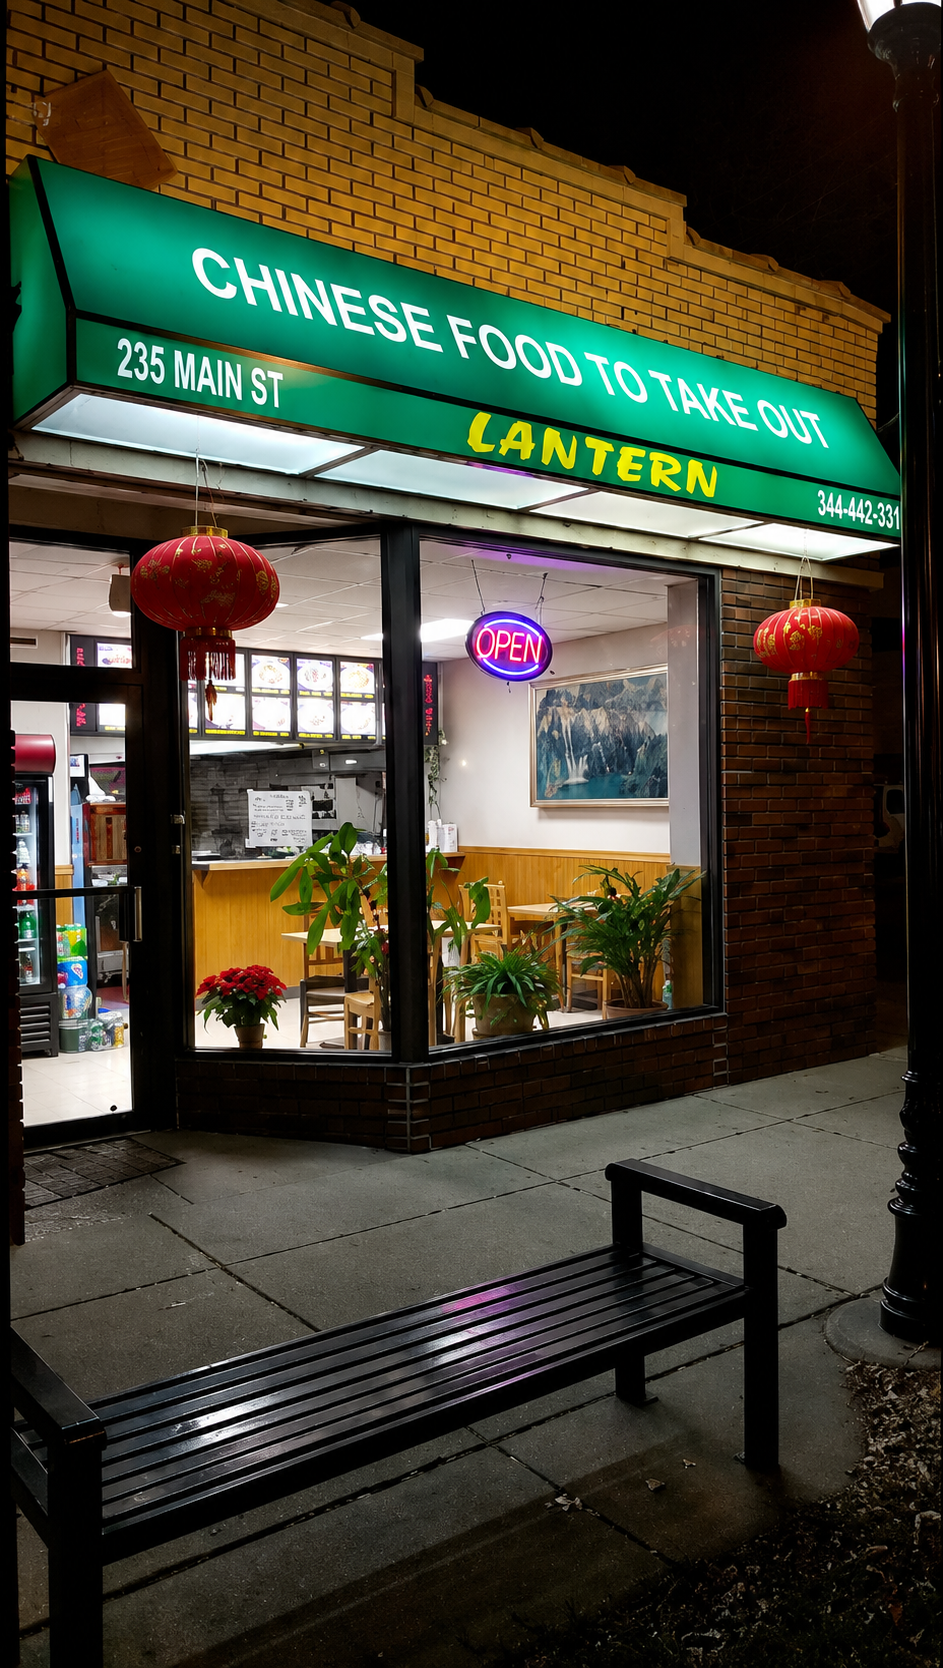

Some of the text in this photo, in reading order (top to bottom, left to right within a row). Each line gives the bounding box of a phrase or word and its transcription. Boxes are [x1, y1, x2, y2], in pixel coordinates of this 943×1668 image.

[117, 337, 285, 409] 235 MAIN ST
[191, 247, 830, 450] CHINESE FOOD TO TAKE OUT
[466, 410, 719, 499] LANTERN
[475, 626, 544, 665] OPEN
